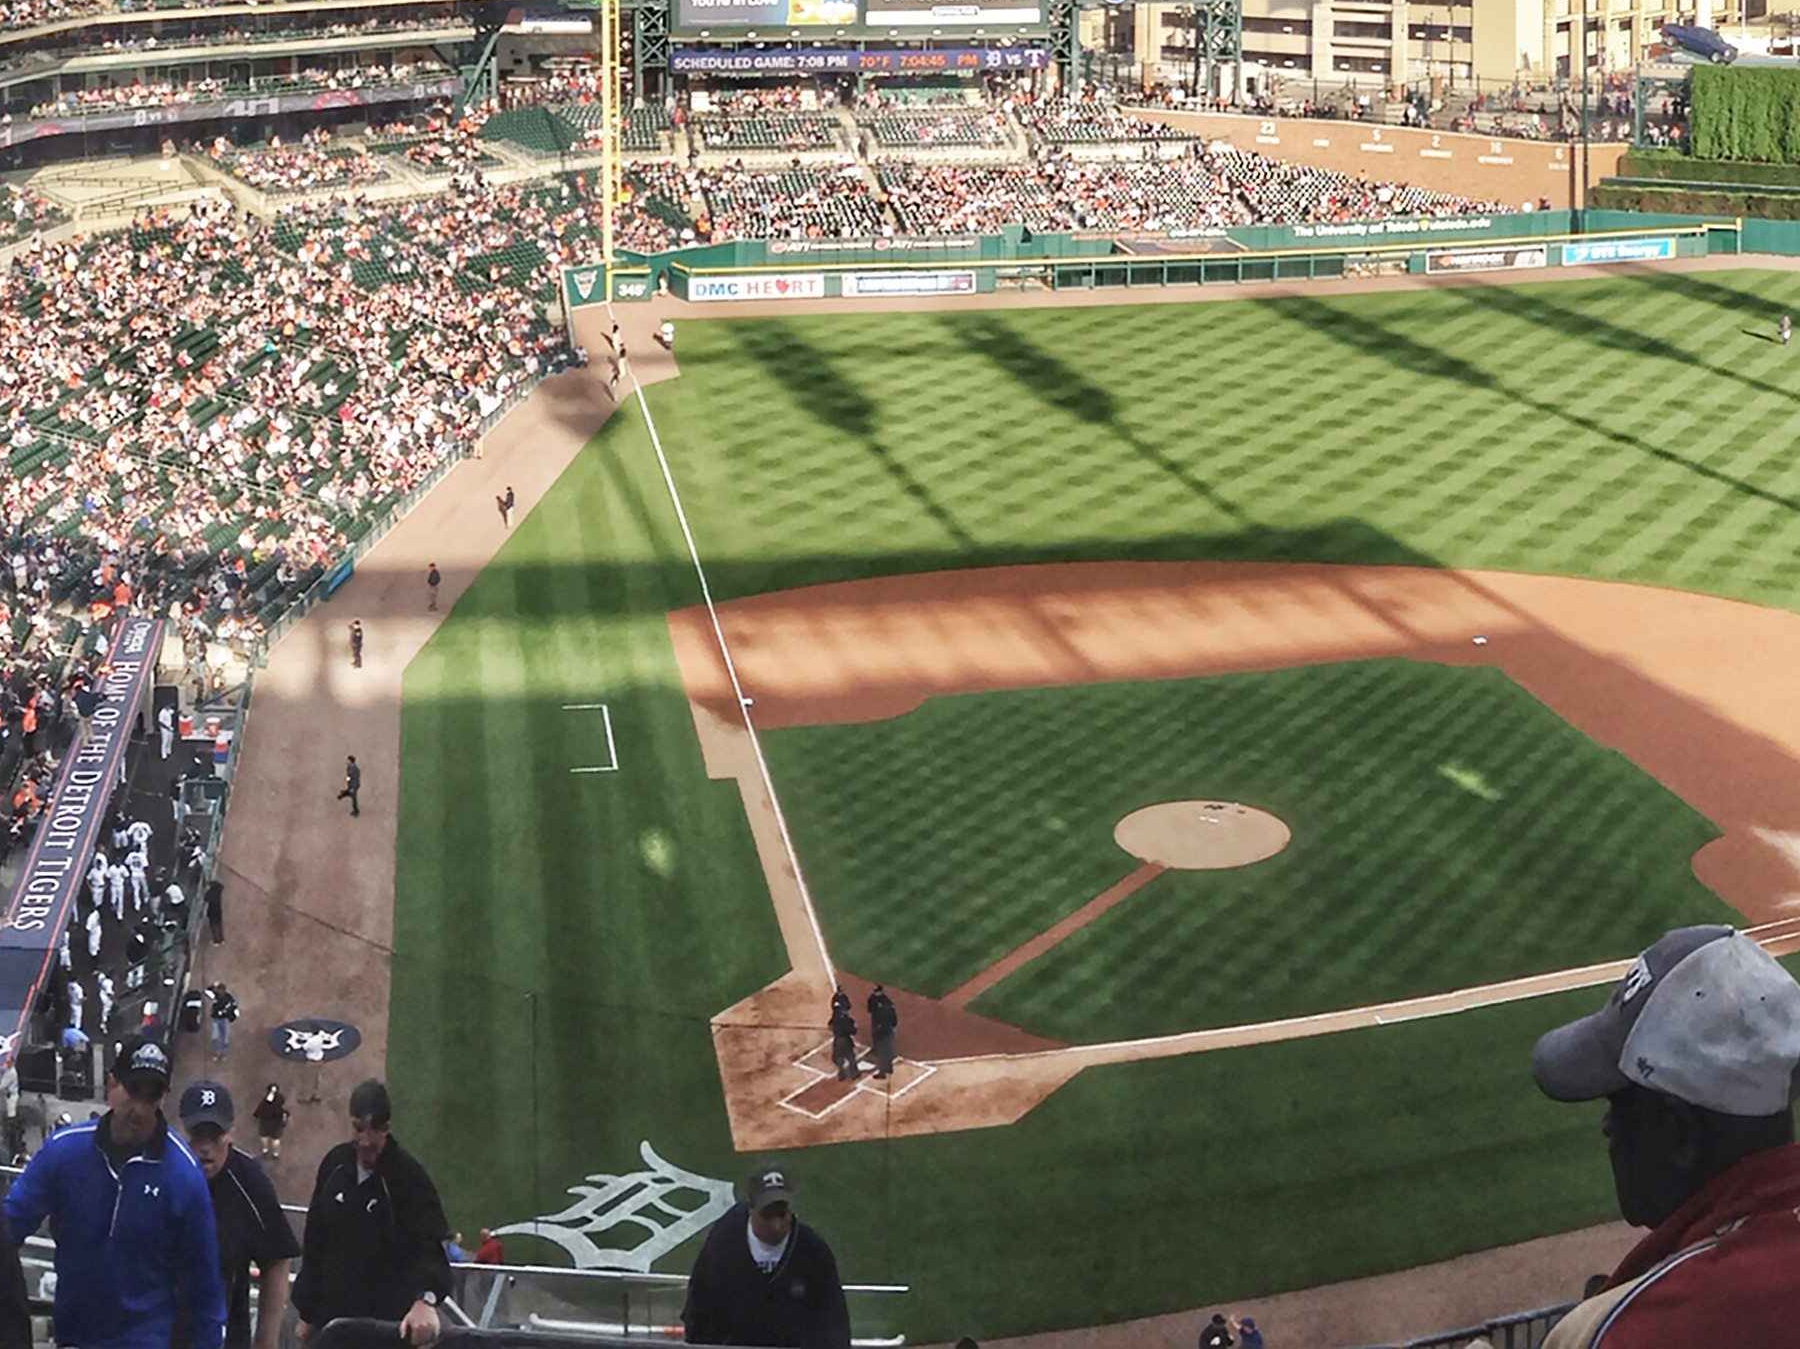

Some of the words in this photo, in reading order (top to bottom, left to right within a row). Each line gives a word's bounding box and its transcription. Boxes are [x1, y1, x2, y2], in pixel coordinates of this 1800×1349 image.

[674, 55, 751, 70] SCHEDULED
[754, 55, 795, 69] GAME:
[798, 55, 825, 69] 7:08
[827, 54, 848, 68] PM
[957, 54, 978, 68] PM
[1260, 122, 1275, 134] 23
[1373, 129, 1382, 141] 5
[1432, 135, 1441, 147] 2
[1294, 224, 1314, 237] The
[1316, 222, 1367, 238] University
[1370, 222, 1384, 233] of
[1386, 220, 1419, 233] Toledo
[786, 240, 810, 252] ATI
[889, 238, 913, 250] ATI
[1616, 245, 1661, 259] Energy
[694, 281, 739, 297] DMC
[112, 660, 139, 706] HOME
[95, 706, 120, 731] OF
[81, 732, 113, 773] THE
[44, 769, 103, 850] DETROIT
[13, 857, 73, 933] TIGERS
